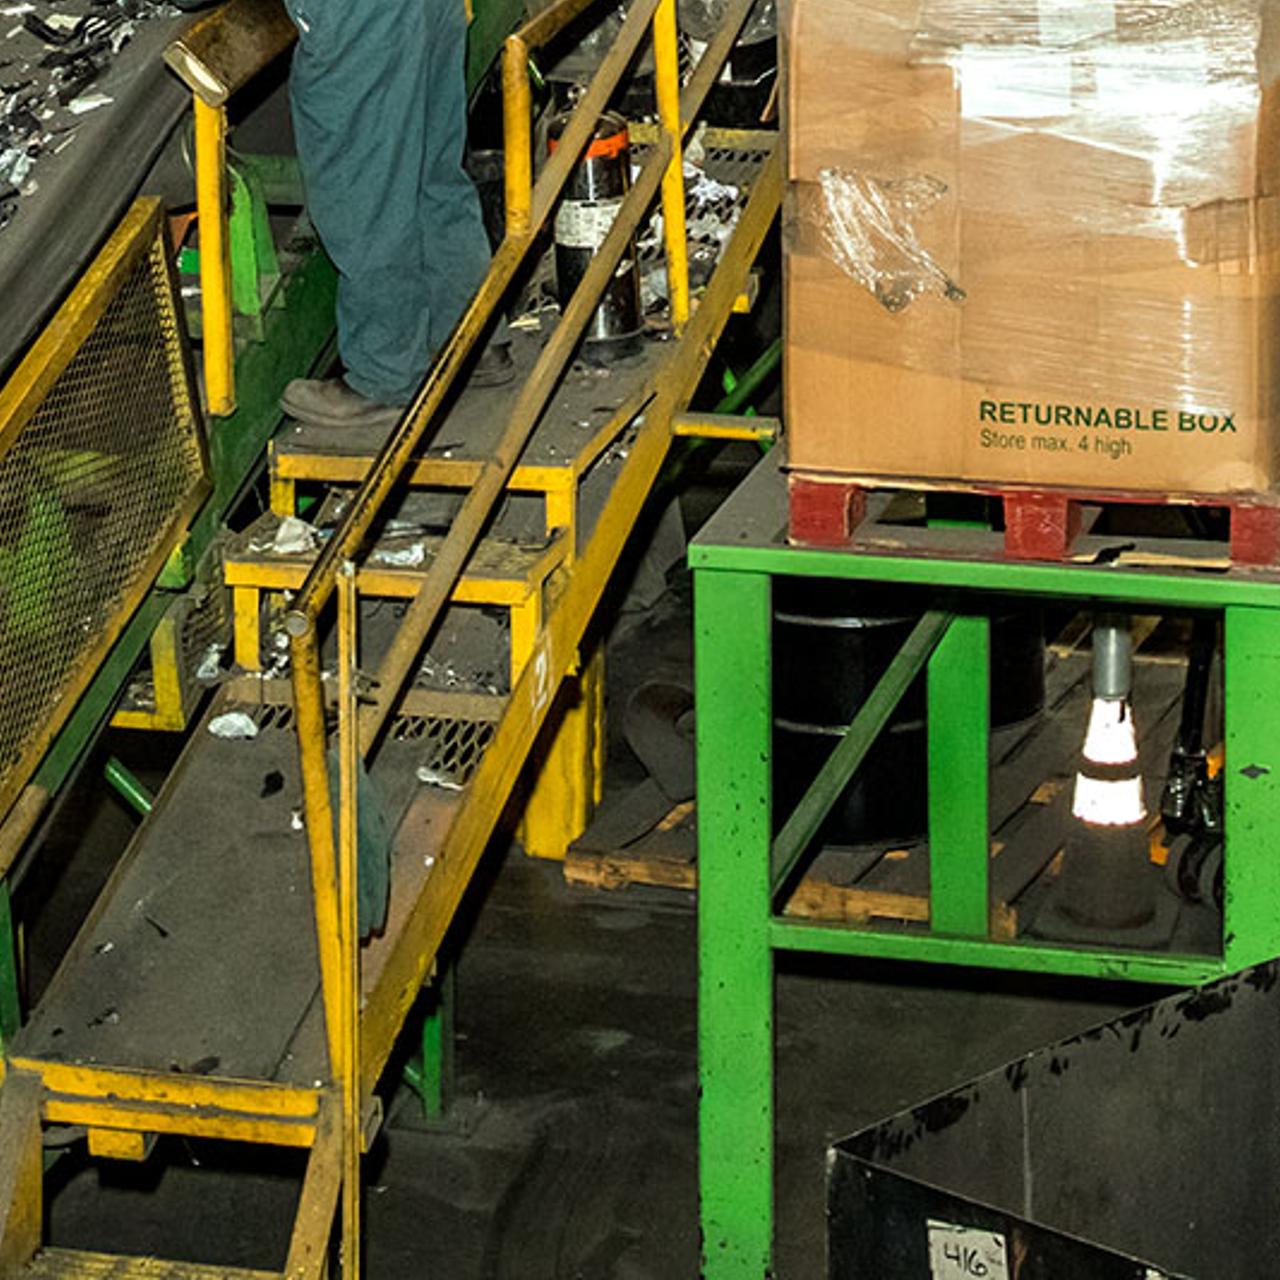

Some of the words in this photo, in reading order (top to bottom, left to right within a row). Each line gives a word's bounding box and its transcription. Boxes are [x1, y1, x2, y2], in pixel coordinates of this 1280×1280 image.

[979, 400, 1169, 431] RETURNABLE
[1177, 410, 1238, 433] BOX
[979, 428, 1025, 450] Store
[1031, 433, 1073, 453] max.
[1077, 434, 1089, 453] 4
[1094, 435, 1133, 460] high
[943, 1242, 989, 1277] 416
